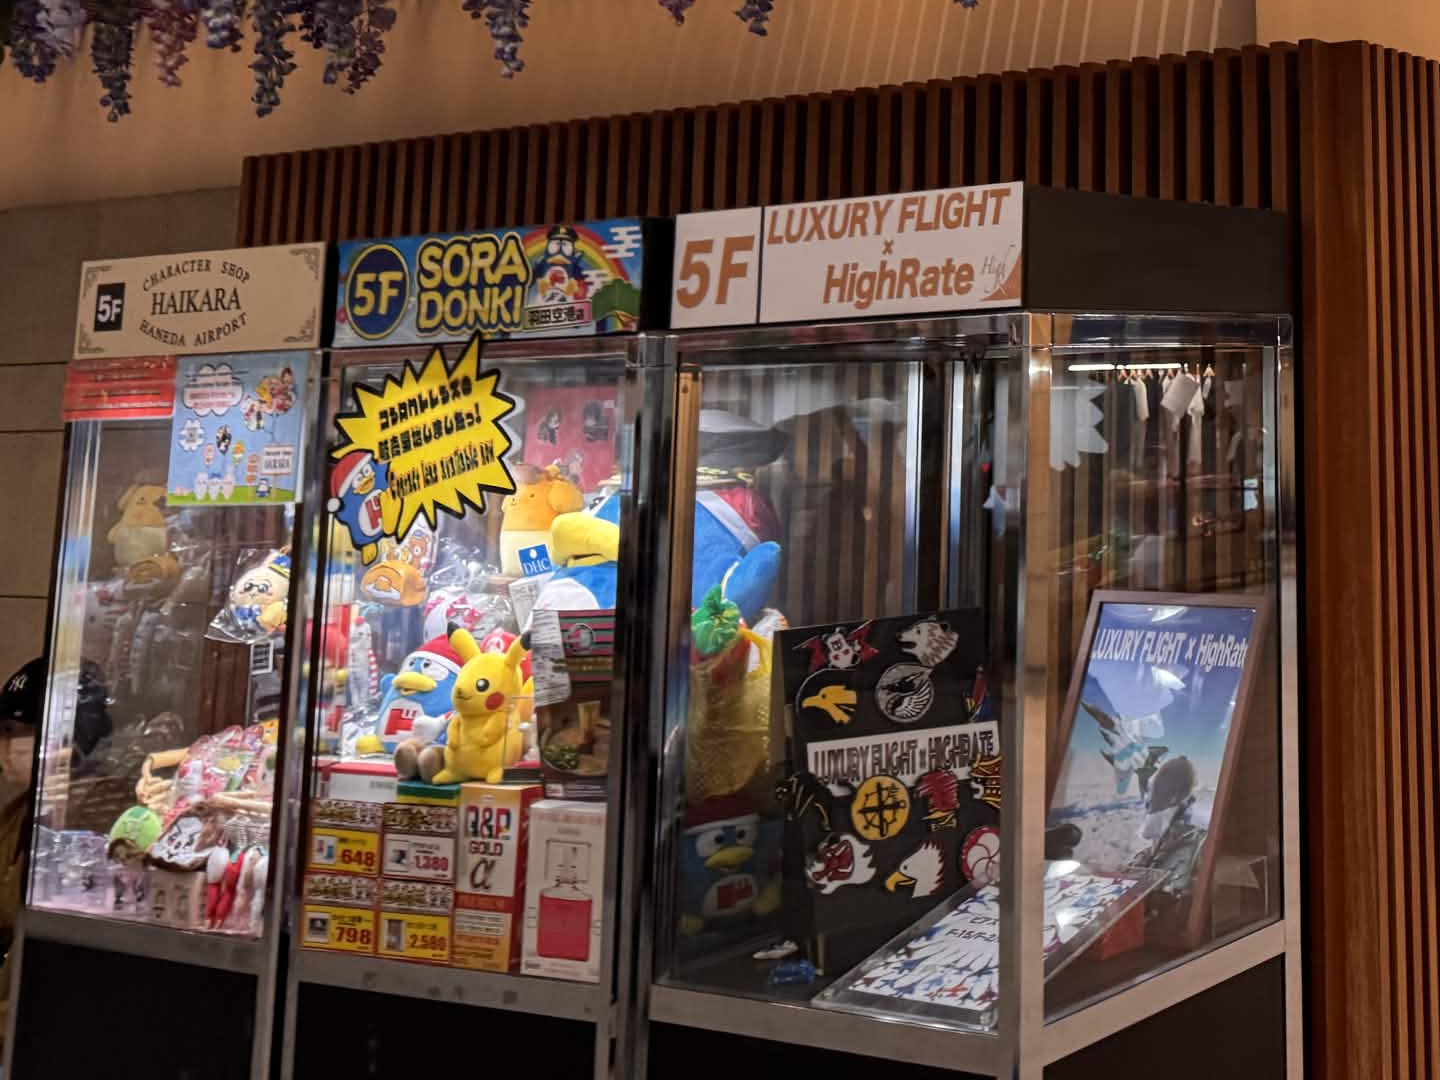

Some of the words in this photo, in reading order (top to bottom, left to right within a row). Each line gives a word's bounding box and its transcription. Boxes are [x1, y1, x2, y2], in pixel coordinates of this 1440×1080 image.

[767, 199, 894, 245] LUXURY
[897, 188, 1012, 234] FLIGHT
[143, 258, 212, 292] CHARACTER
[221, 260, 251, 285] SHOP
[418, 237, 527, 289] SORA
[676, 235, 755, 309] 5F
[352, 270, 403, 317] 5F
[823, 257, 974, 310] HighRate
[97, 295, 123, 322] 5F
[151, 287, 242, 315] HAIKARA
[418, 285, 524, 330] DONKI
[139, 319, 187, 347] HANEDA
[193, 312, 248, 346] AIRPORT
[522, 558, 550, 576] DHC
[1142, 631, 1187, 664] FLIGHT
[871, 739, 919, 777] FLIGHT
[341, 849, 376, 868] 648
[468, 840, 504, 856] GOLD
[335, 926, 371, 945] 798
